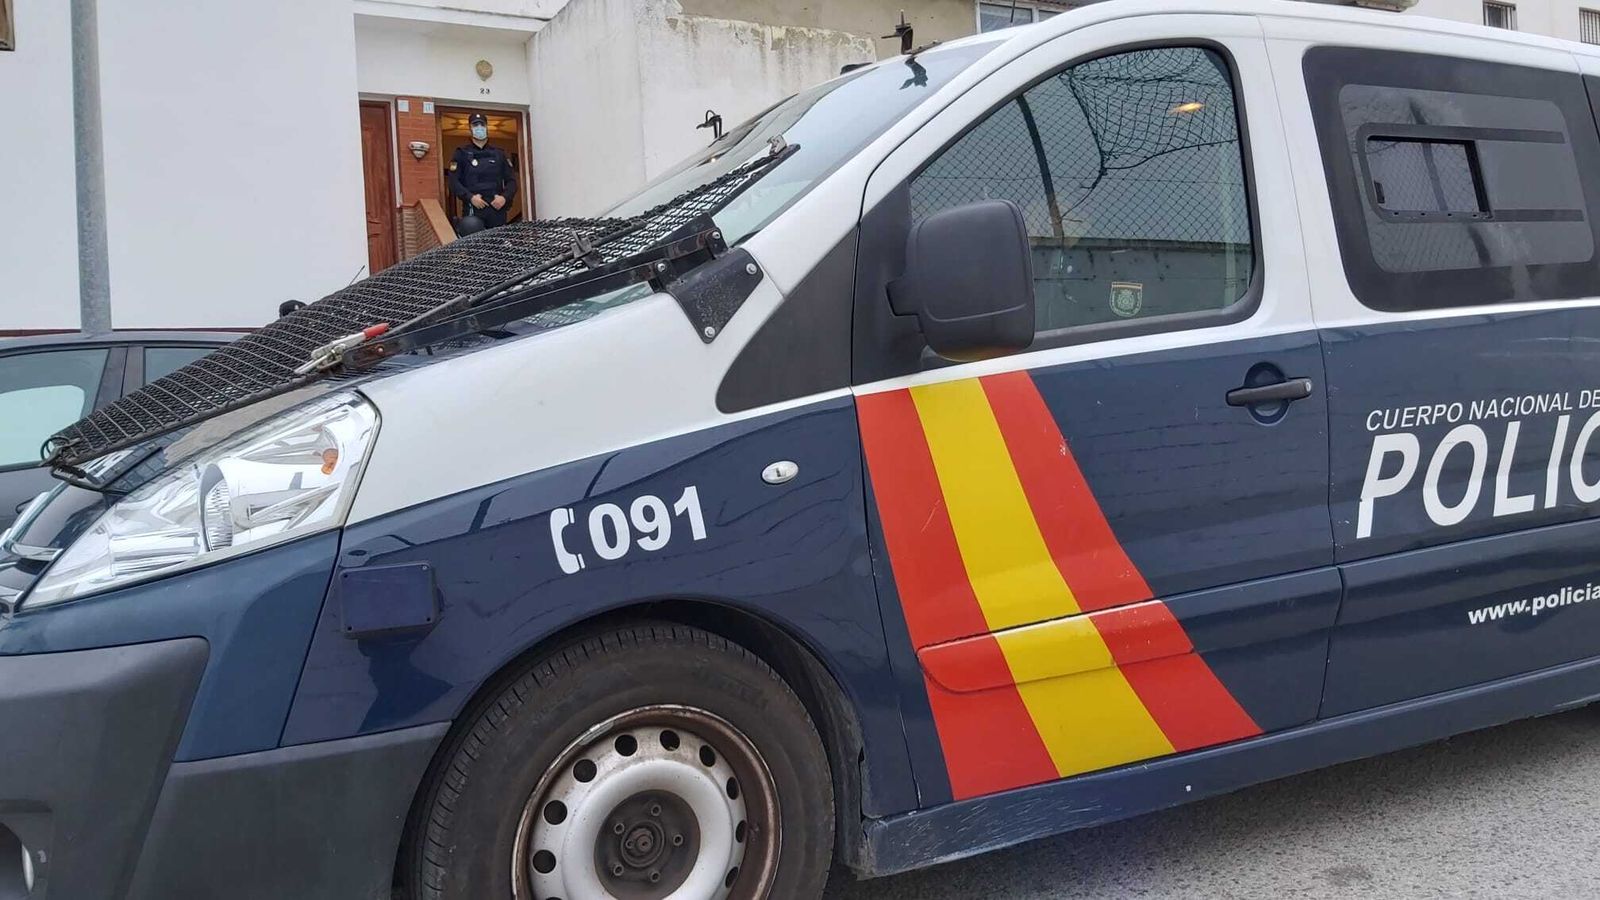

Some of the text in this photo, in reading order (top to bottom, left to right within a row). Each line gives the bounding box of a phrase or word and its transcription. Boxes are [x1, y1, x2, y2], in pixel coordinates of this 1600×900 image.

[479, 87, 491, 95] 23
[1366, 389, 1600, 431] CUERPO NACIONAL DE
[588, 485, 707, 560] 091
[1468, 582, 1600, 625] www.policia
